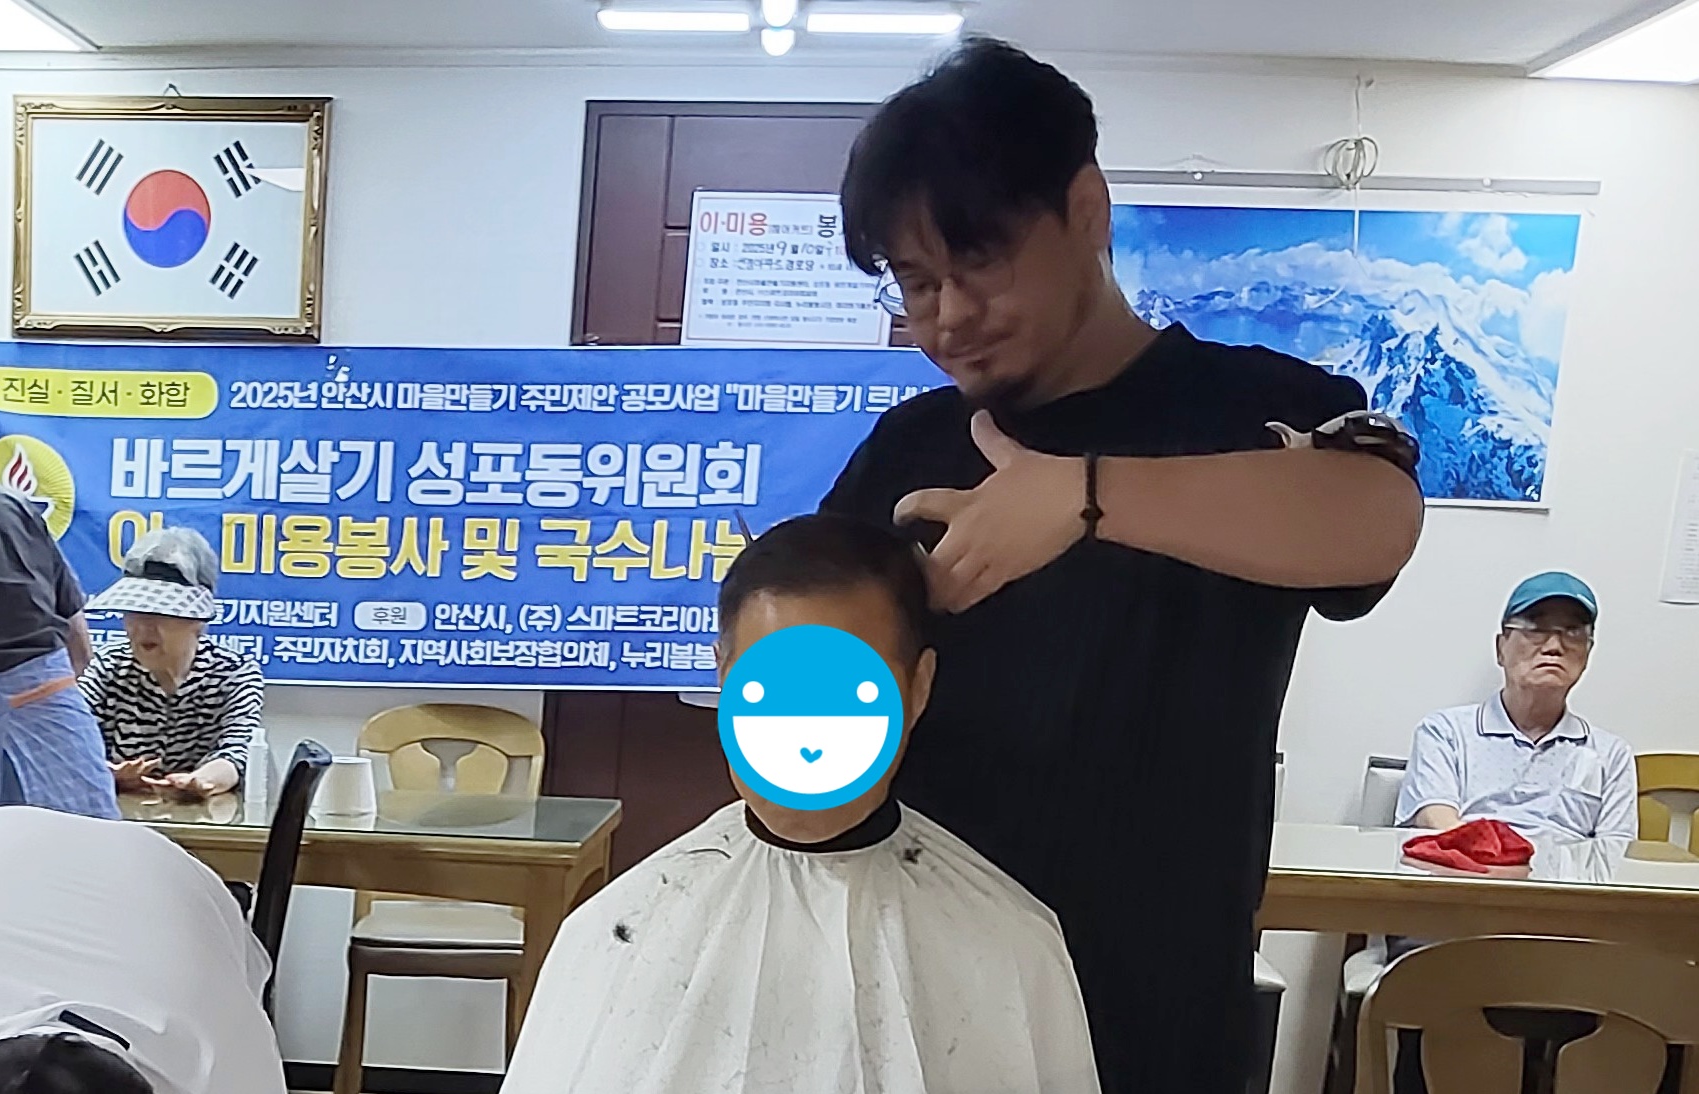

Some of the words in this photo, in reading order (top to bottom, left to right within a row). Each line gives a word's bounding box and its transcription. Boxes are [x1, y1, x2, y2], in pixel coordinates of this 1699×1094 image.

[2, 378, 50, 404] 진실
[70, 380, 120, 409] 질서
[138, 380, 191, 409] 화합
[230, 381, 318, 410] 2025년
[320, 382, 393, 410] 안산시
[397, 383, 517, 412] 마을만들기
[520, 384, 619, 413] 주민제안
[622, 384, 721, 413] 공모사업
[725, 383, 862, 414] "마을만들기
[110, 436, 395, 503] 바르게살기
[406, 440, 763, 507] 성포동위원회
[460, 516, 521, 582] 및
[371, 606, 408, 623] 후원
[433, 604, 514, 634] 안산시,
[517, 605, 562, 633] (주)
[273, 635, 395, 667] 주민자치회,
[397, 639, 617, 672] 지역사회보장협의체,
